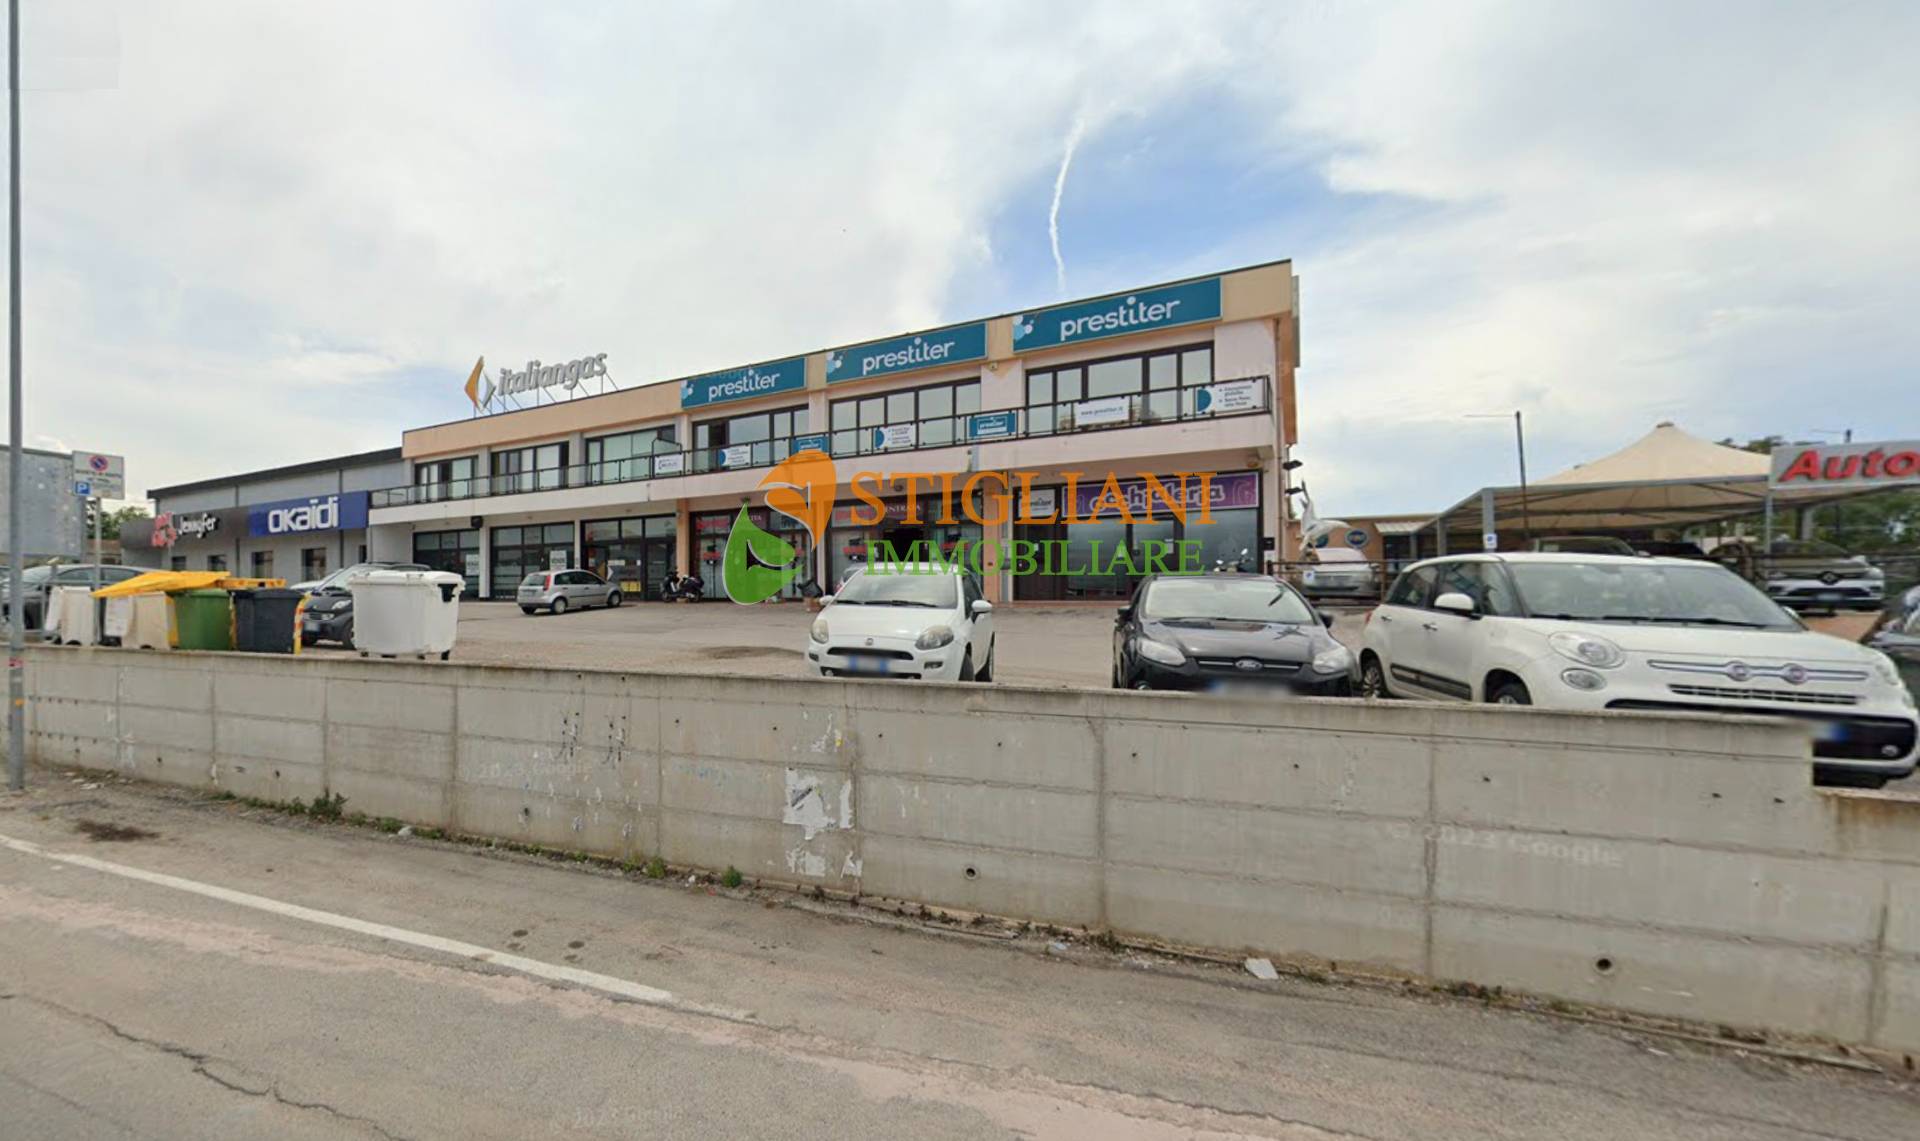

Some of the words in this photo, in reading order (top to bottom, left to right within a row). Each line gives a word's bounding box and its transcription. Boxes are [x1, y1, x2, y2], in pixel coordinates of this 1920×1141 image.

[1060, 295, 1180, 342] prestiter
[497, 352, 608, 396] italiangas
[863, 336, 955, 376] prestiter
[708, 368, 781, 402] prestiter
[1776, 447, 1920, 483] Auto
